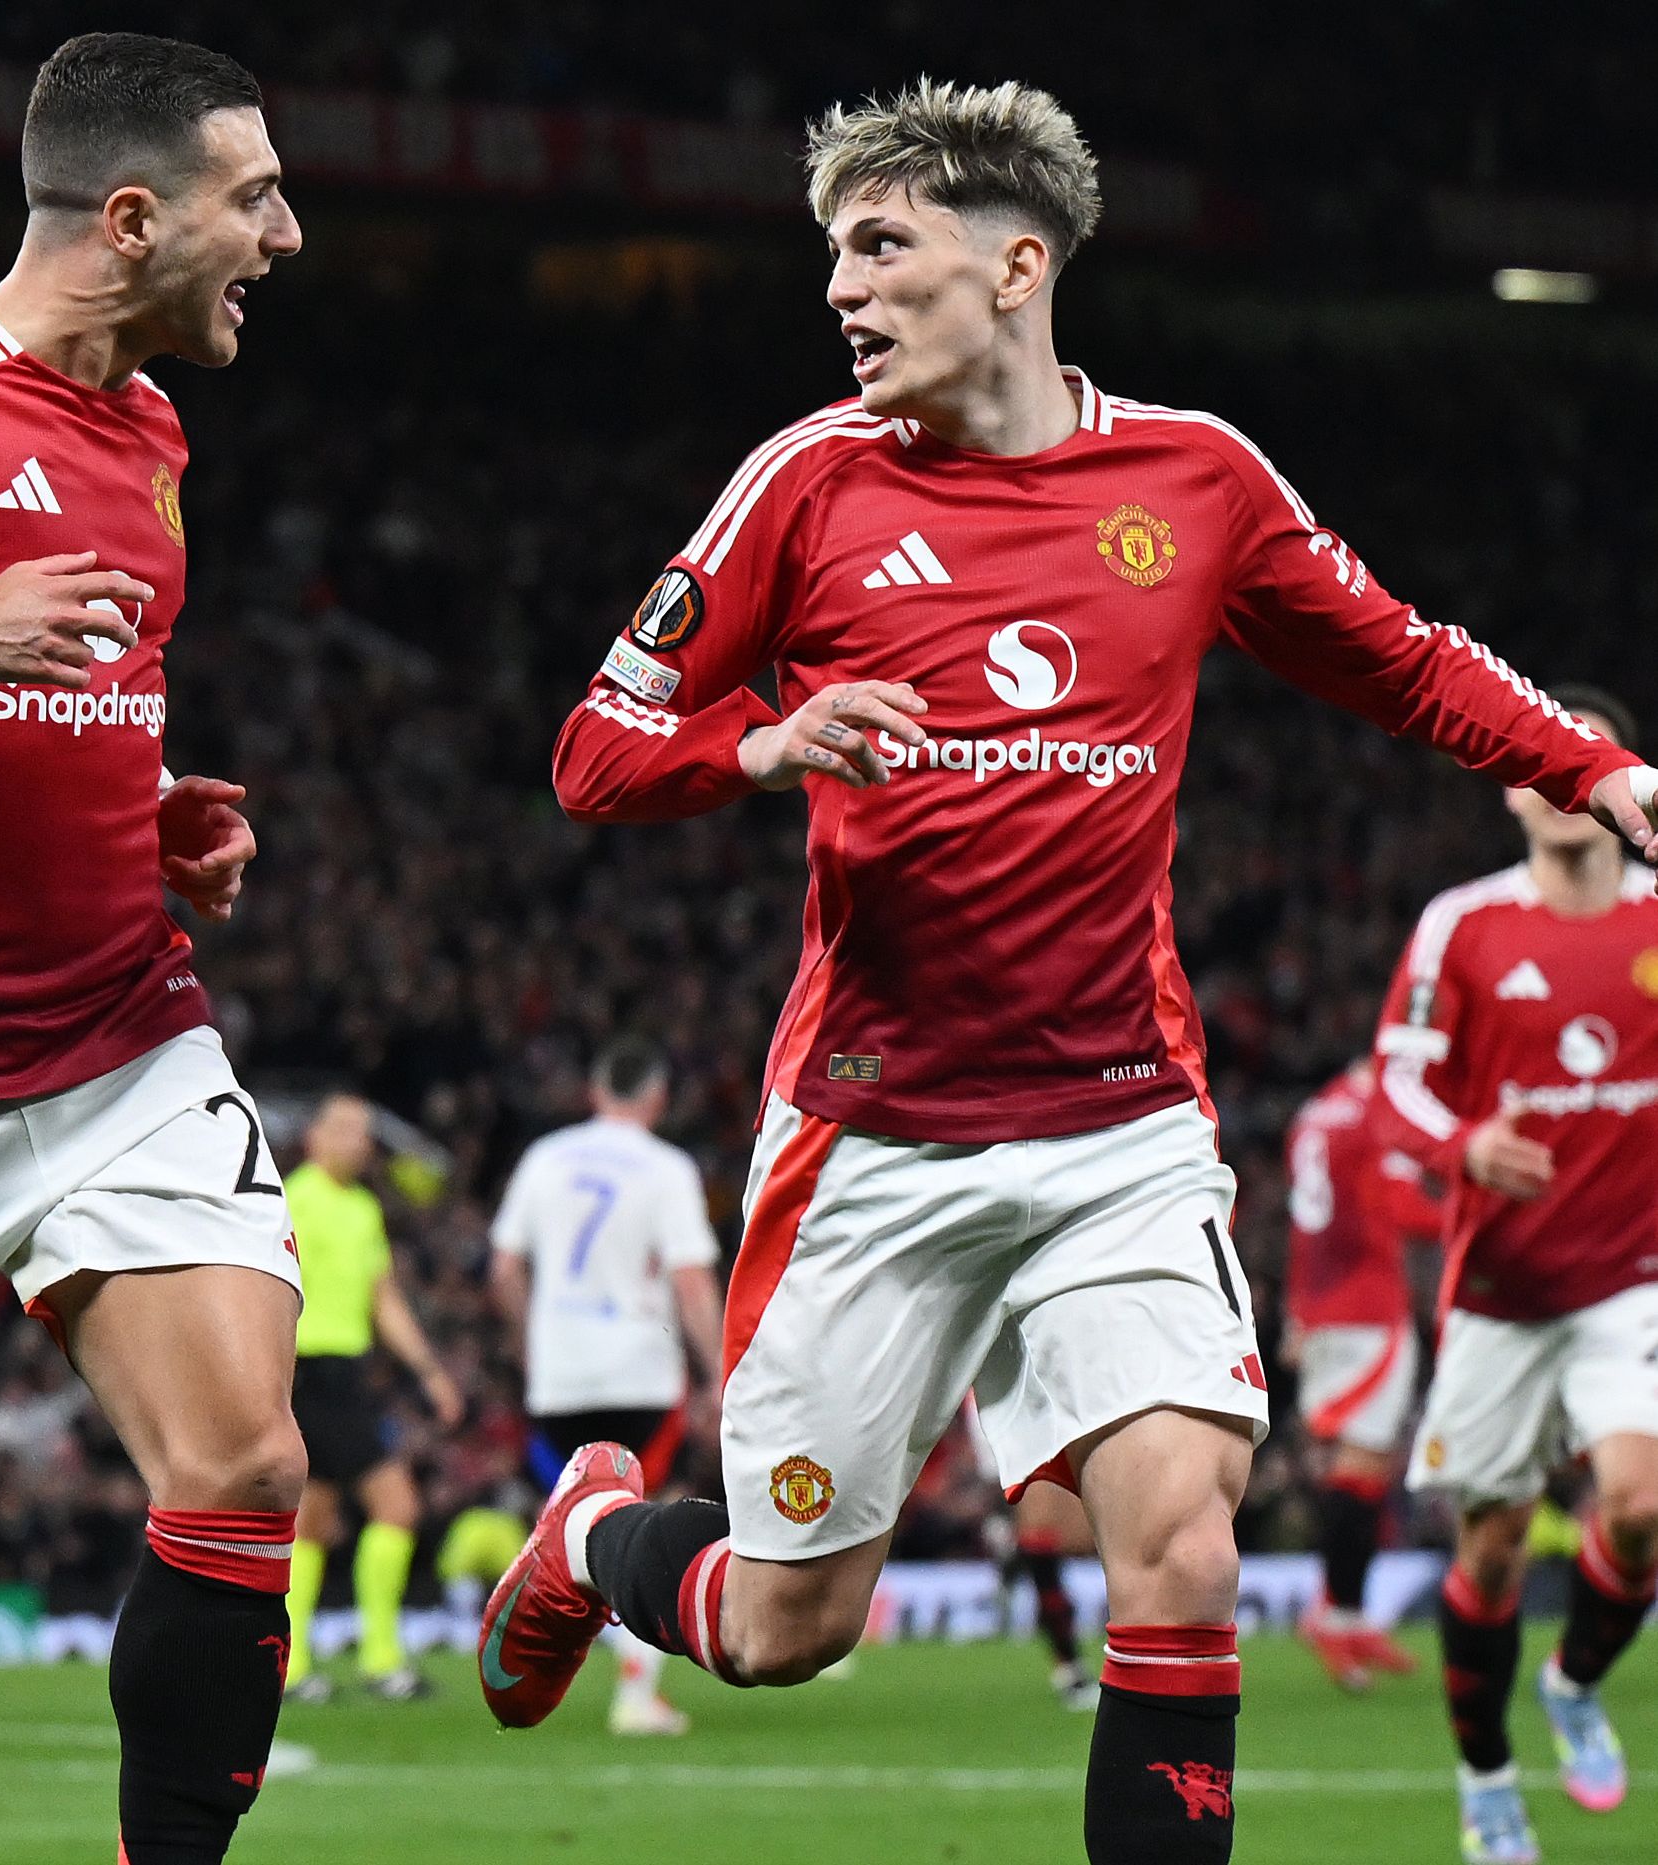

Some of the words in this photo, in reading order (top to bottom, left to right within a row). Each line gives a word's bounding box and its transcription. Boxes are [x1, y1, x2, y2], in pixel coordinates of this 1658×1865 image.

[1120, 566, 1163, 581] UNITED
[876, 728, 1157, 788] Snapdragon
[1102, 1063, 1158, 1083] HEAT.RDY
[205, 1093, 282, 1197] 2
[568, 1174, 618, 1279] 7
